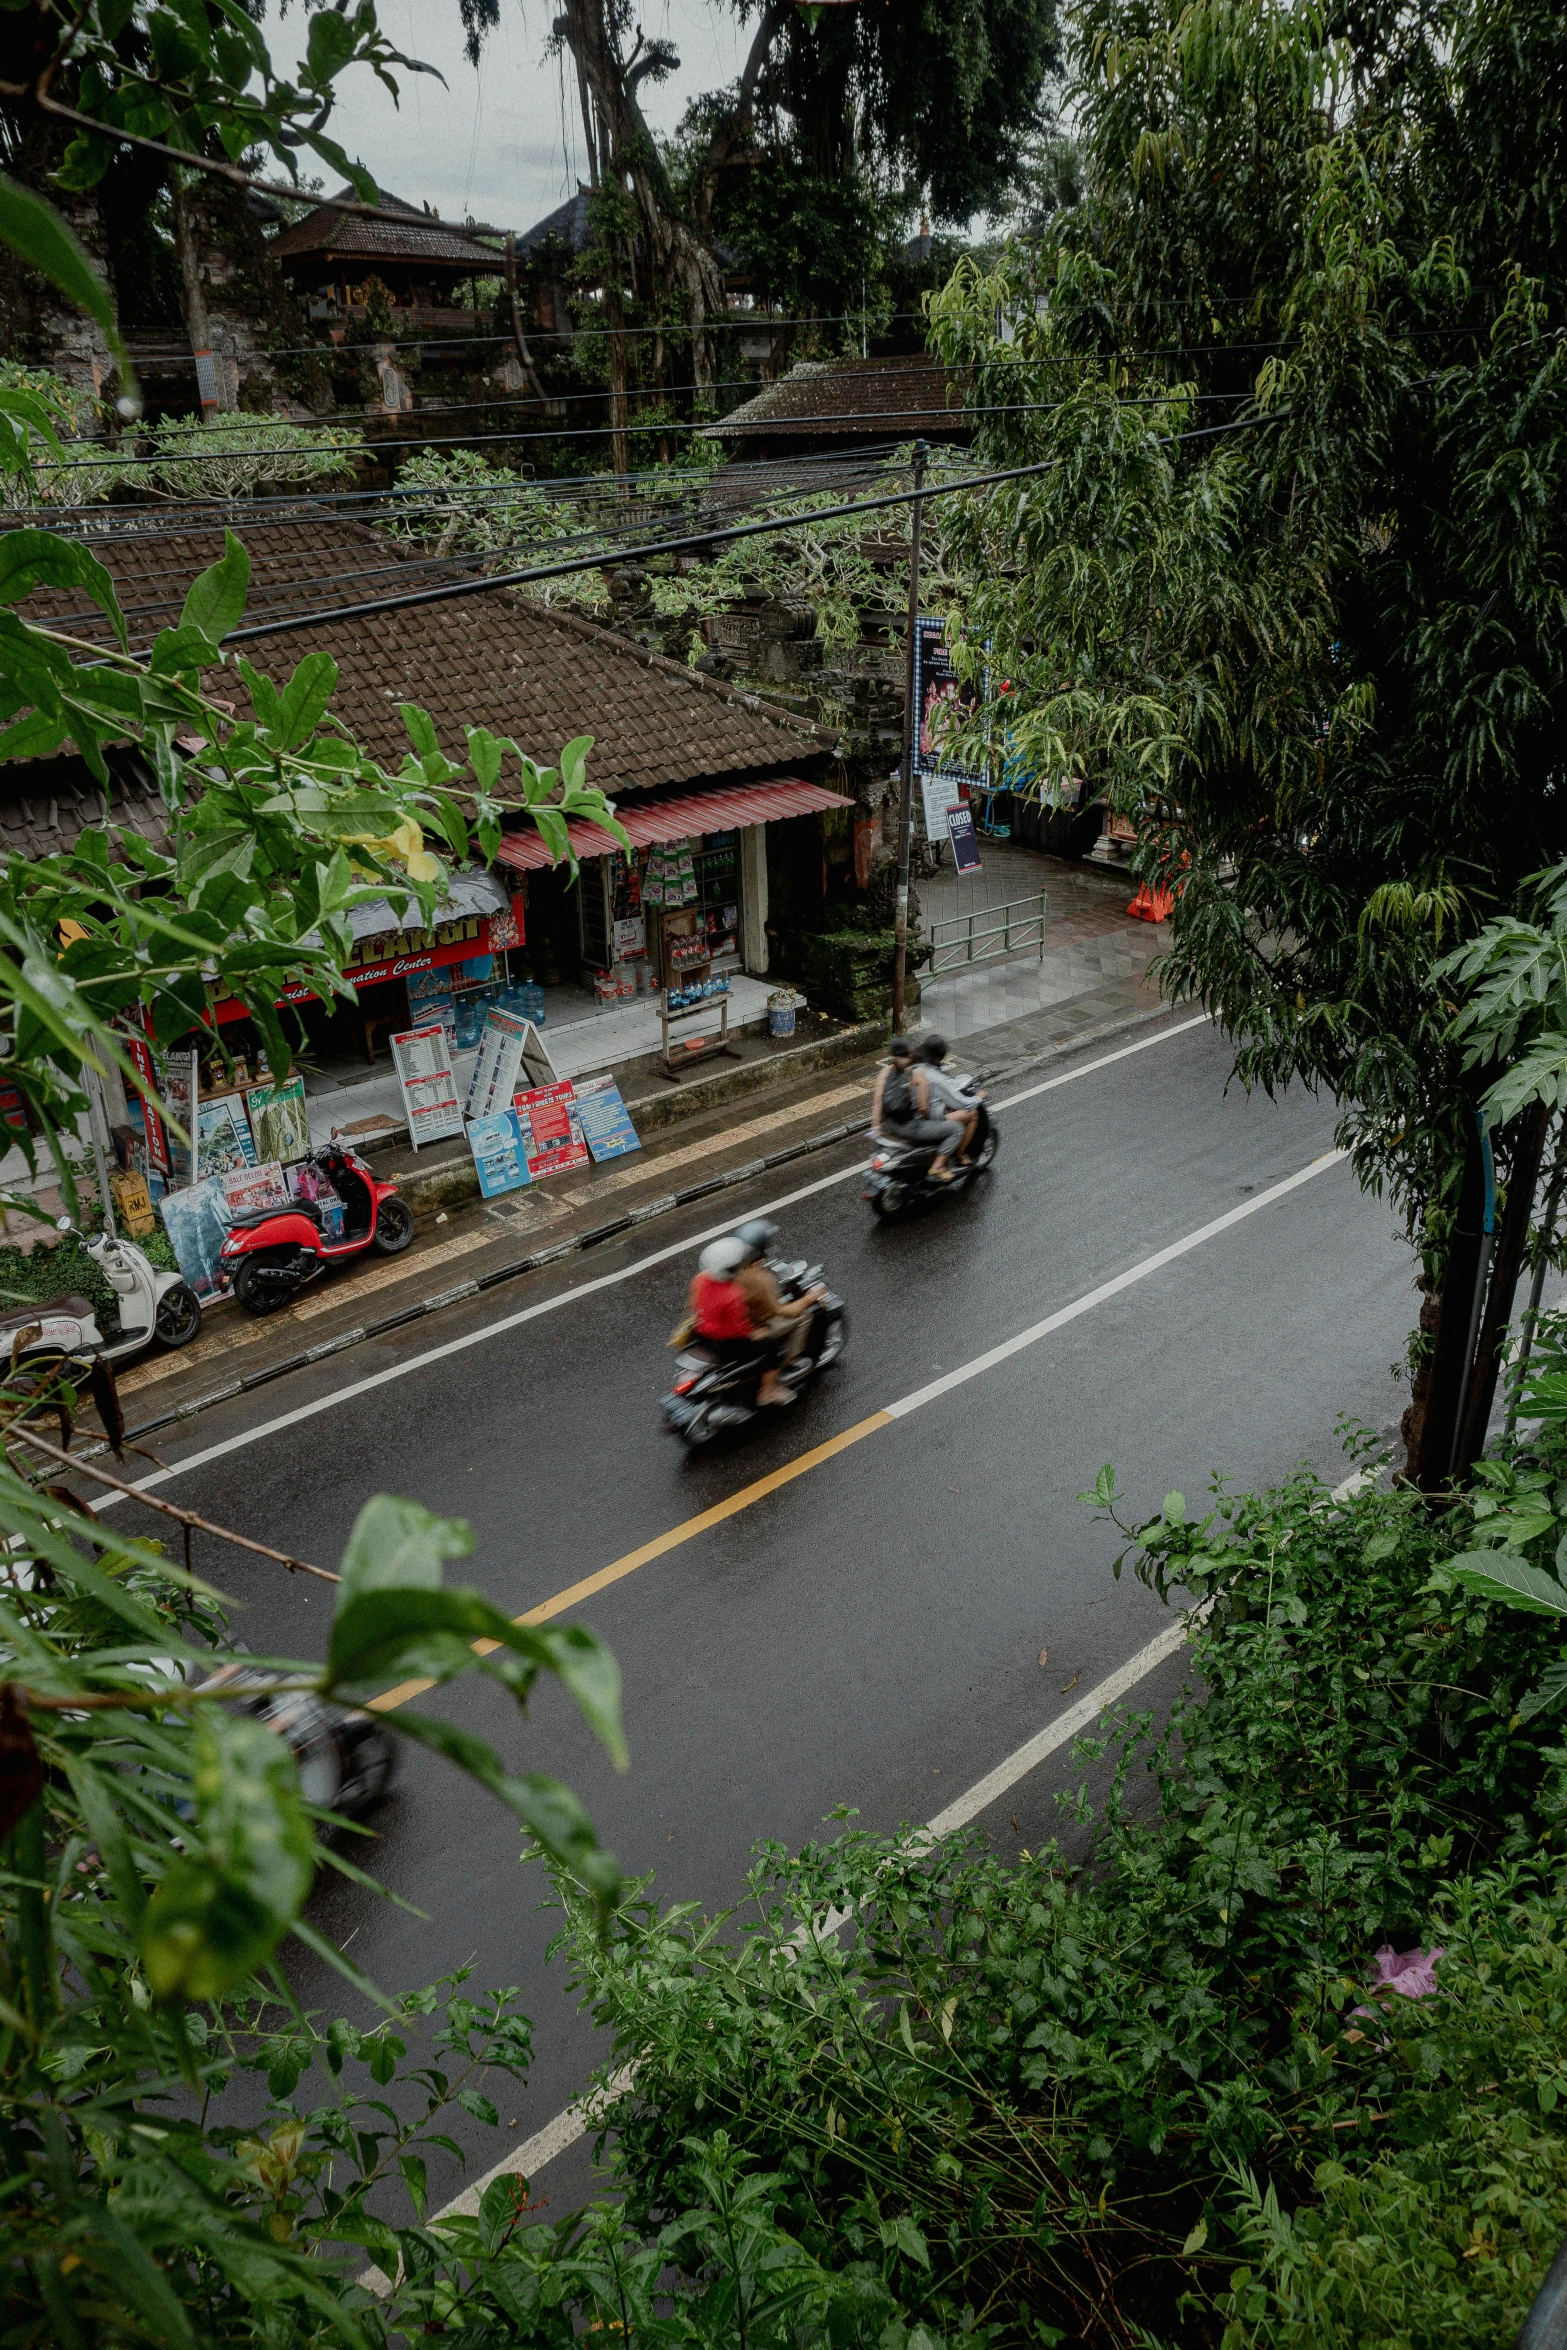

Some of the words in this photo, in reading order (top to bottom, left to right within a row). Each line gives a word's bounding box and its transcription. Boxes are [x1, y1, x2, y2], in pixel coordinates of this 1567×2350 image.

[948, 810, 972, 828] CLOSED
[340, 918, 478, 972] ELANGI
[392, 959, 432, 976] Center
[535, 1097, 555, 1108] BREEZE
[555, 1091, 573, 1101] TOURS
[228, 1173, 244, 1185] BALE
